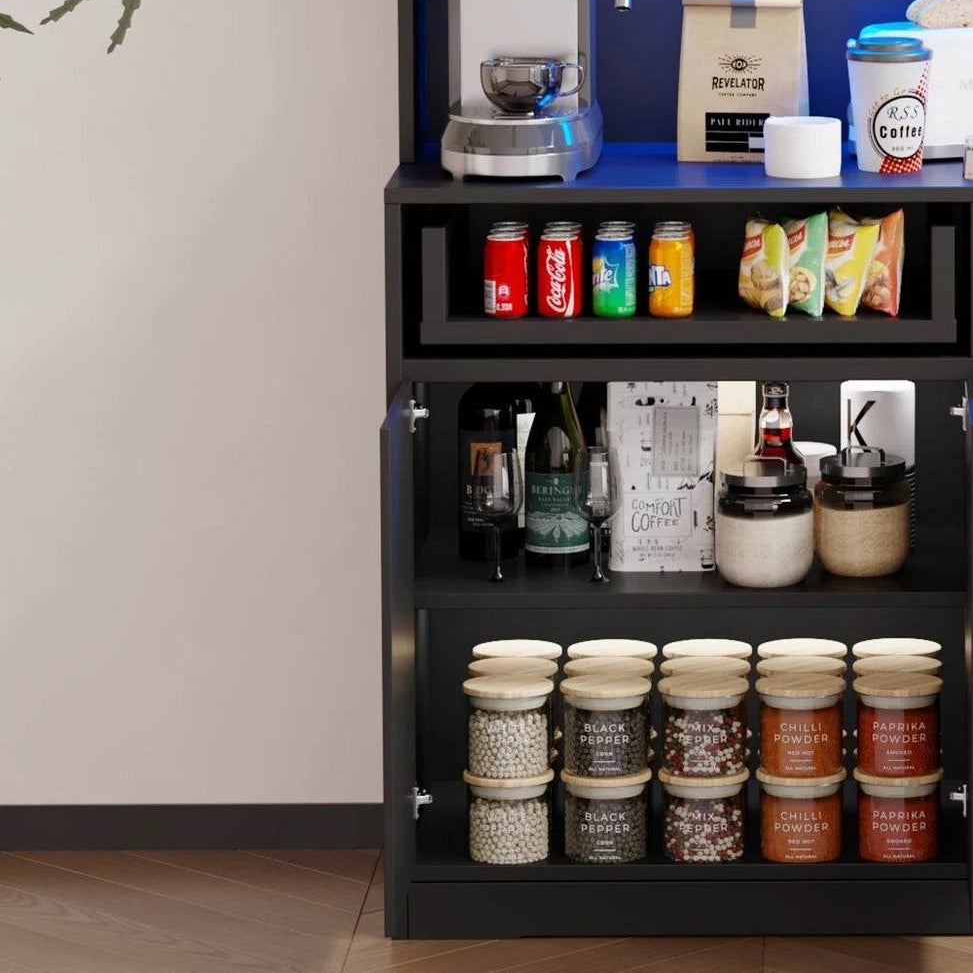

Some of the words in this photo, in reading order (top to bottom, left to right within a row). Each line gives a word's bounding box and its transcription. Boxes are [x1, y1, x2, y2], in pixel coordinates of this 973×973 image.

[711, 76, 765, 91] REVELATOR
[879, 125, 923, 139] Coffee
[631, 496, 687, 518] COMFORT
[631, 510, 680, 532] COFFEE
[584, 723, 626, 733] BLACK
[691, 723, 715, 732] MIX
[779, 722, 822, 732] CHILLI
[872, 721, 926, 731] PAPRIKA
[580, 735, 630, 745] PEPPER
[678, 735, 728, 744] PEPPER
[774, 733, 829, 744] POWDER
[872, 733, 927, 744] POWDER
[584, 812, 626, 822] BLACK
[691, 812, 716, 821] MIX
[780, 811, 822, 821] CHILLI
[872, 810, 926, 820] PAPRIKA
[581, 823, 630, 834] PEPPER
[679, 823, 728, 833] PEPPER
[774, 822, 829, 833] POWDER
[872, 821, 927, 832] POWDER
